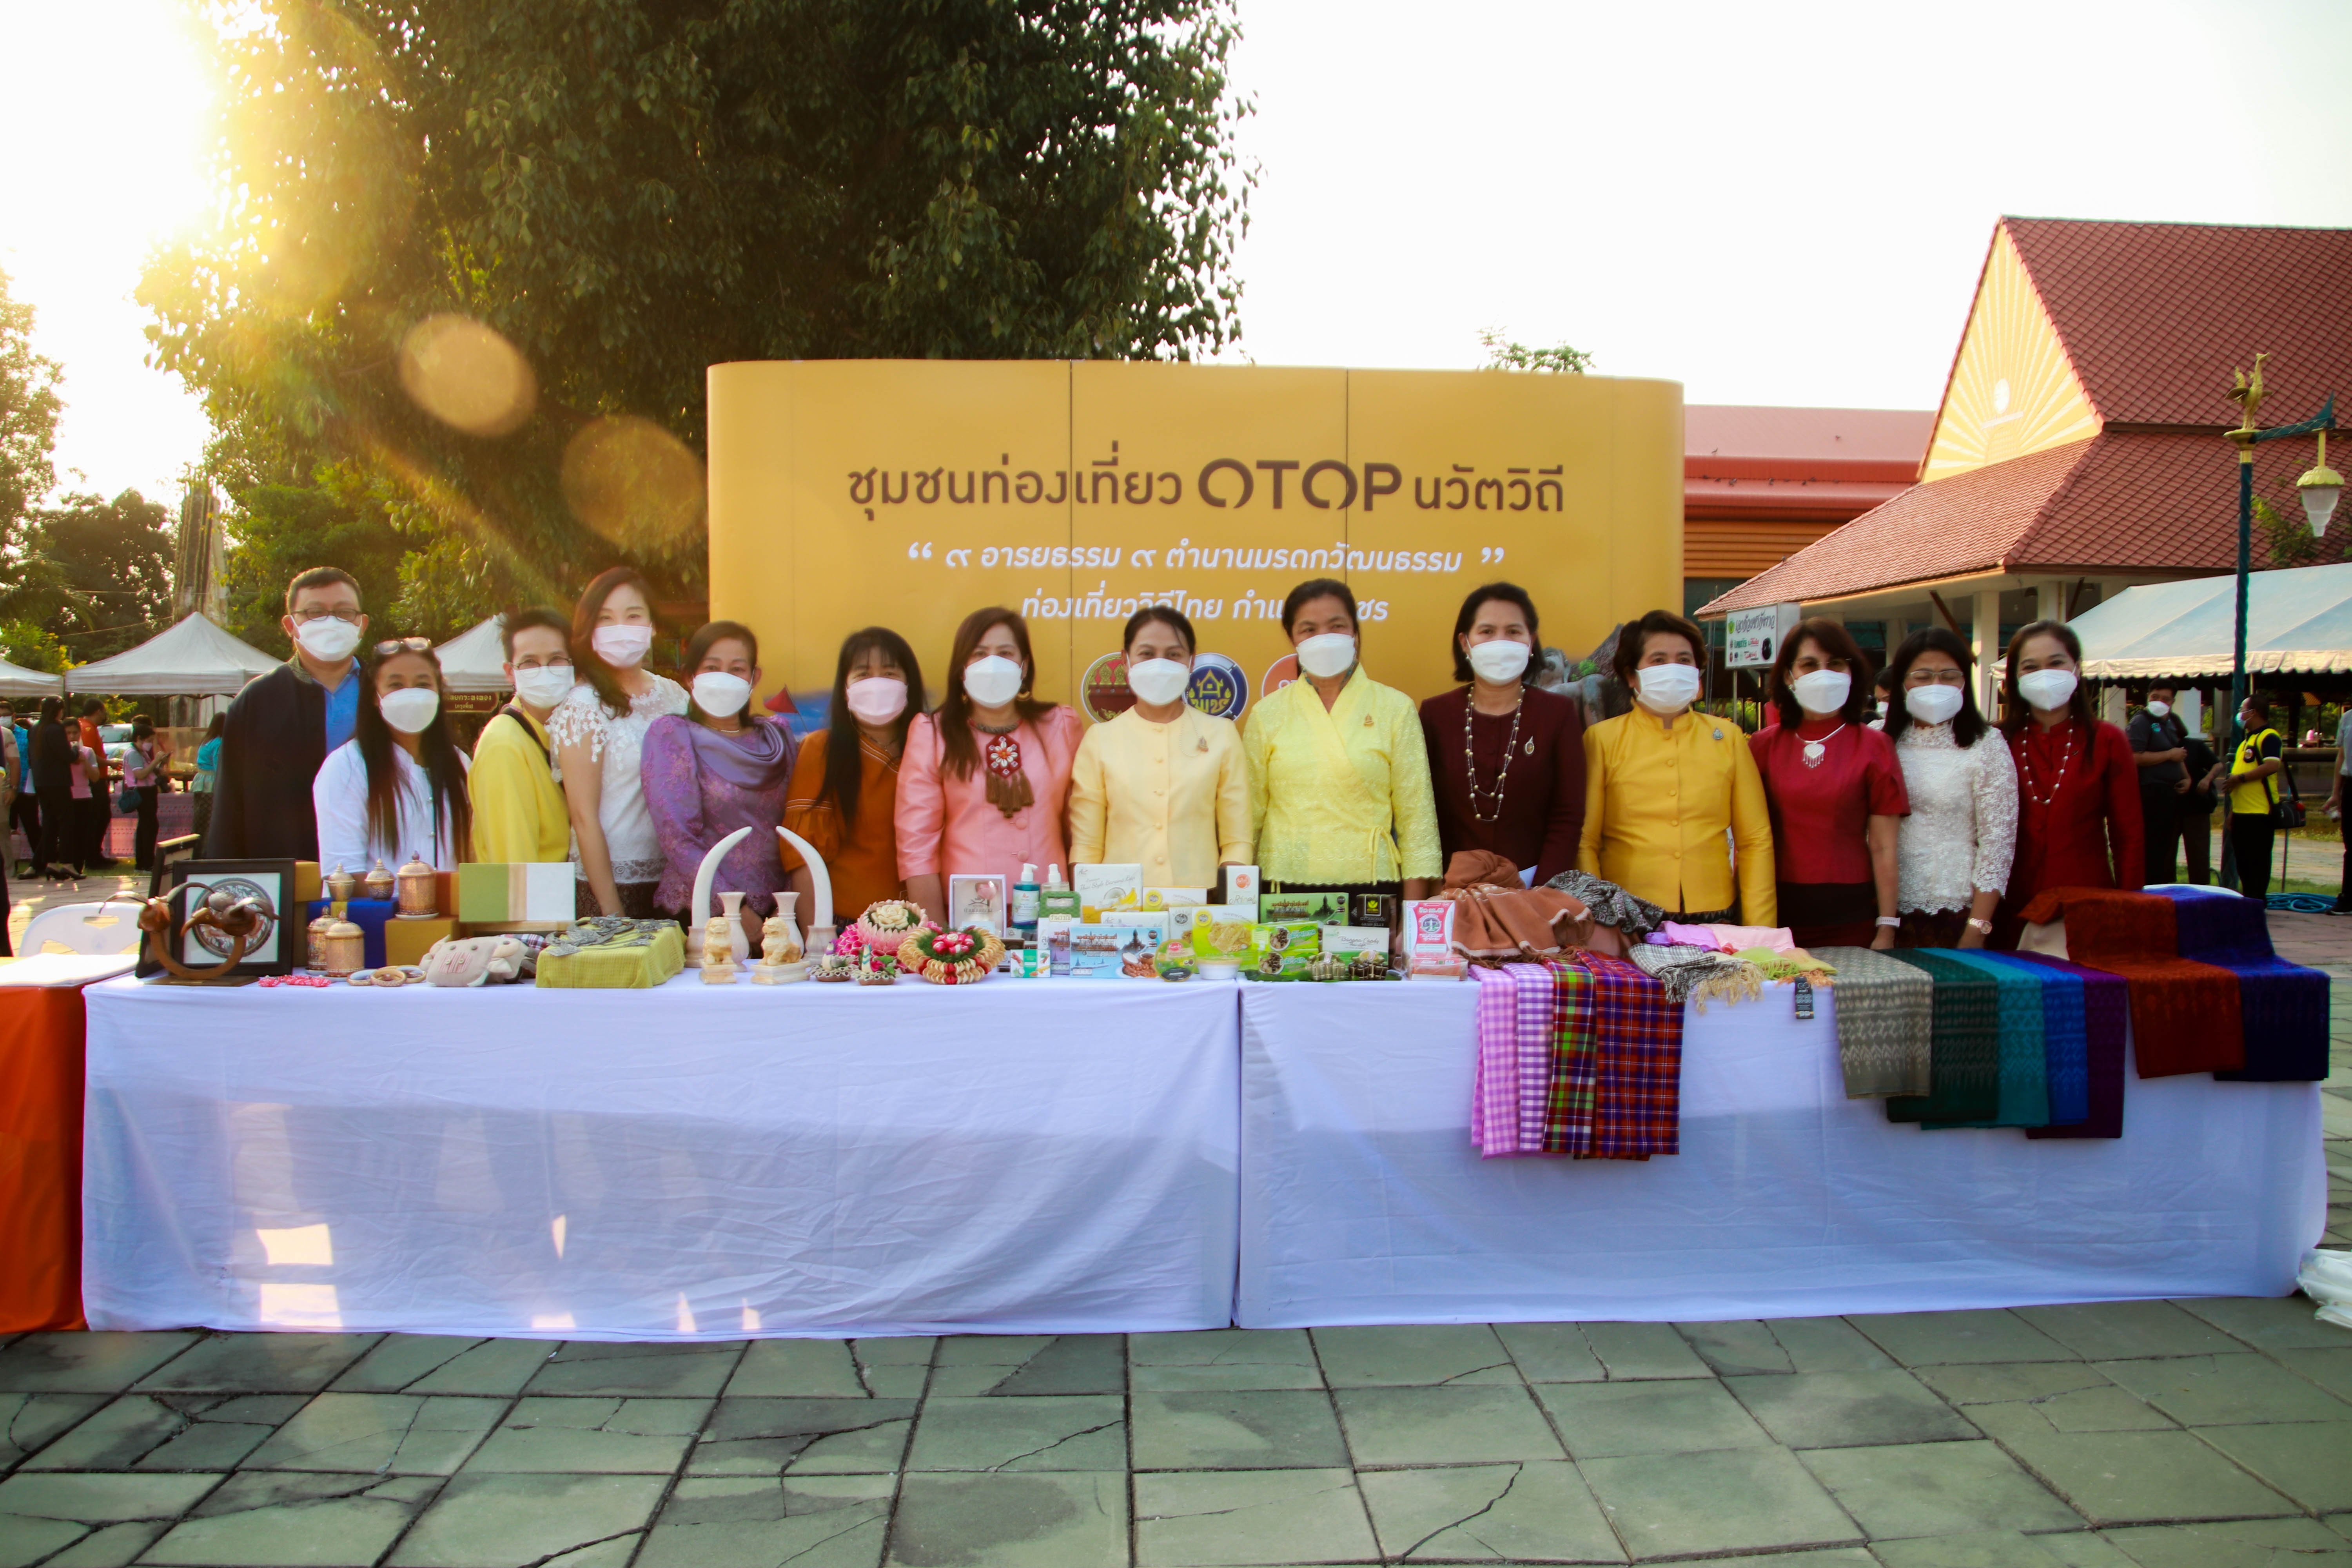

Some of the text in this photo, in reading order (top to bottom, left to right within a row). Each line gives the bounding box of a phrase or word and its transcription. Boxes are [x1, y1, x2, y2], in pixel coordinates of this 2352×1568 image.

[848, 440, 1563, 521] ชุมชนท่องเที่ยว OTOP นวัตวิถี
[981, 546, 1121, 567] อารยธรรม
[1165, 538, 1462, 572] ตำนานมรดกวัฒนธรรม
[1233, 589, 1389, 621] กำแชร
